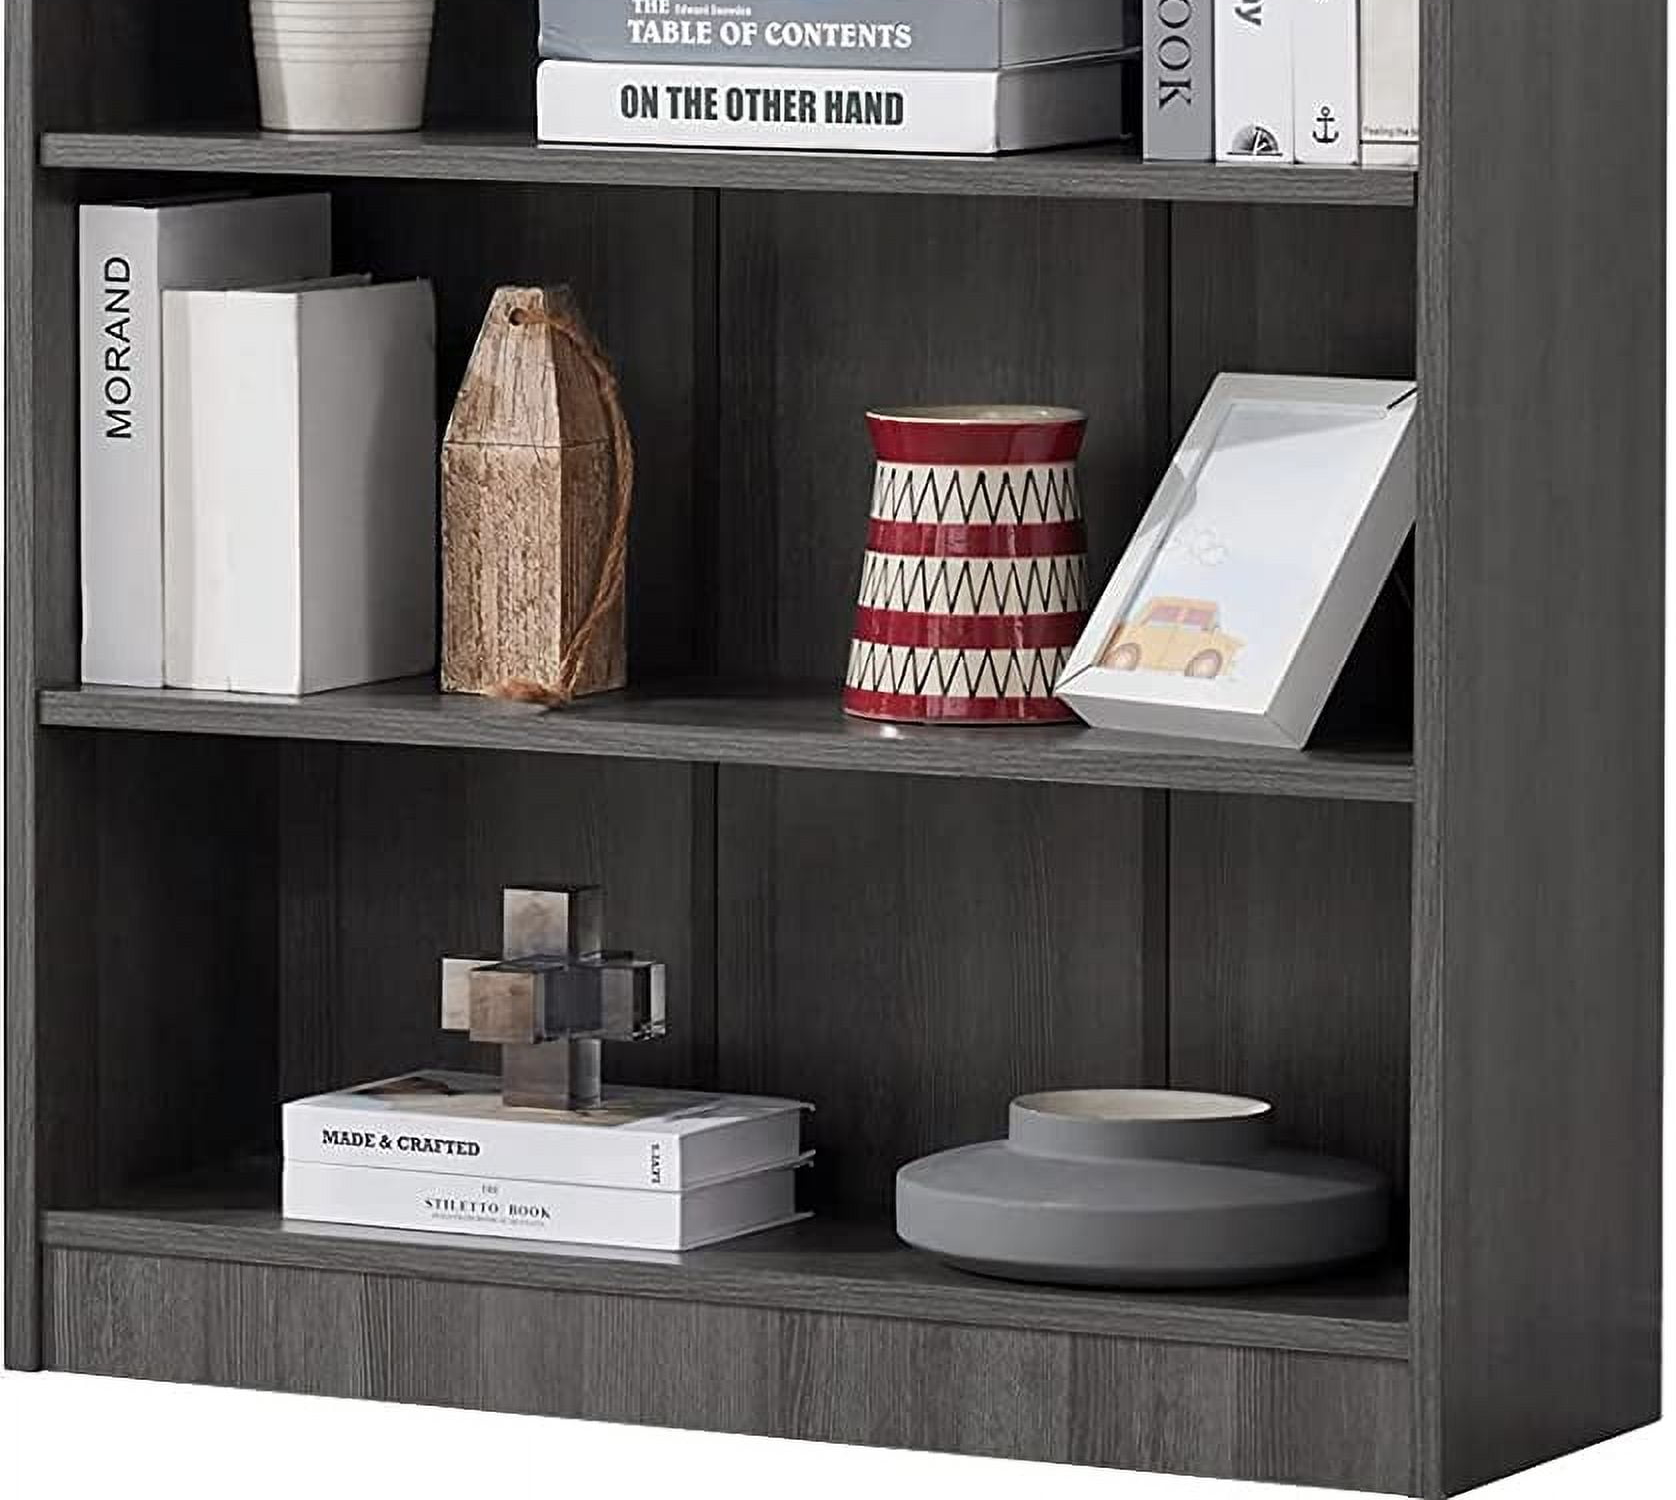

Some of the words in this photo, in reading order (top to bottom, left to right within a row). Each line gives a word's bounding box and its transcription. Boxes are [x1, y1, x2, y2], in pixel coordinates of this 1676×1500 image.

[627, 19, 712, 45] TABLE
[719, 21, 758, 47] OF
[764, 22, 912, 48] CONTENTS
[621, 84, 659, 119] ON
[666, 86, 717, 121] THE
[725, 88, 816, 123] OTHER
[825, 91, 903, 126] HAND
[104, 257, 131, 438] MORAND
[322, 1130, 376, 1149] MADE
[379, 1133, 393, 1150] &
[397, 1135, 481, 1157] CRAFTED
